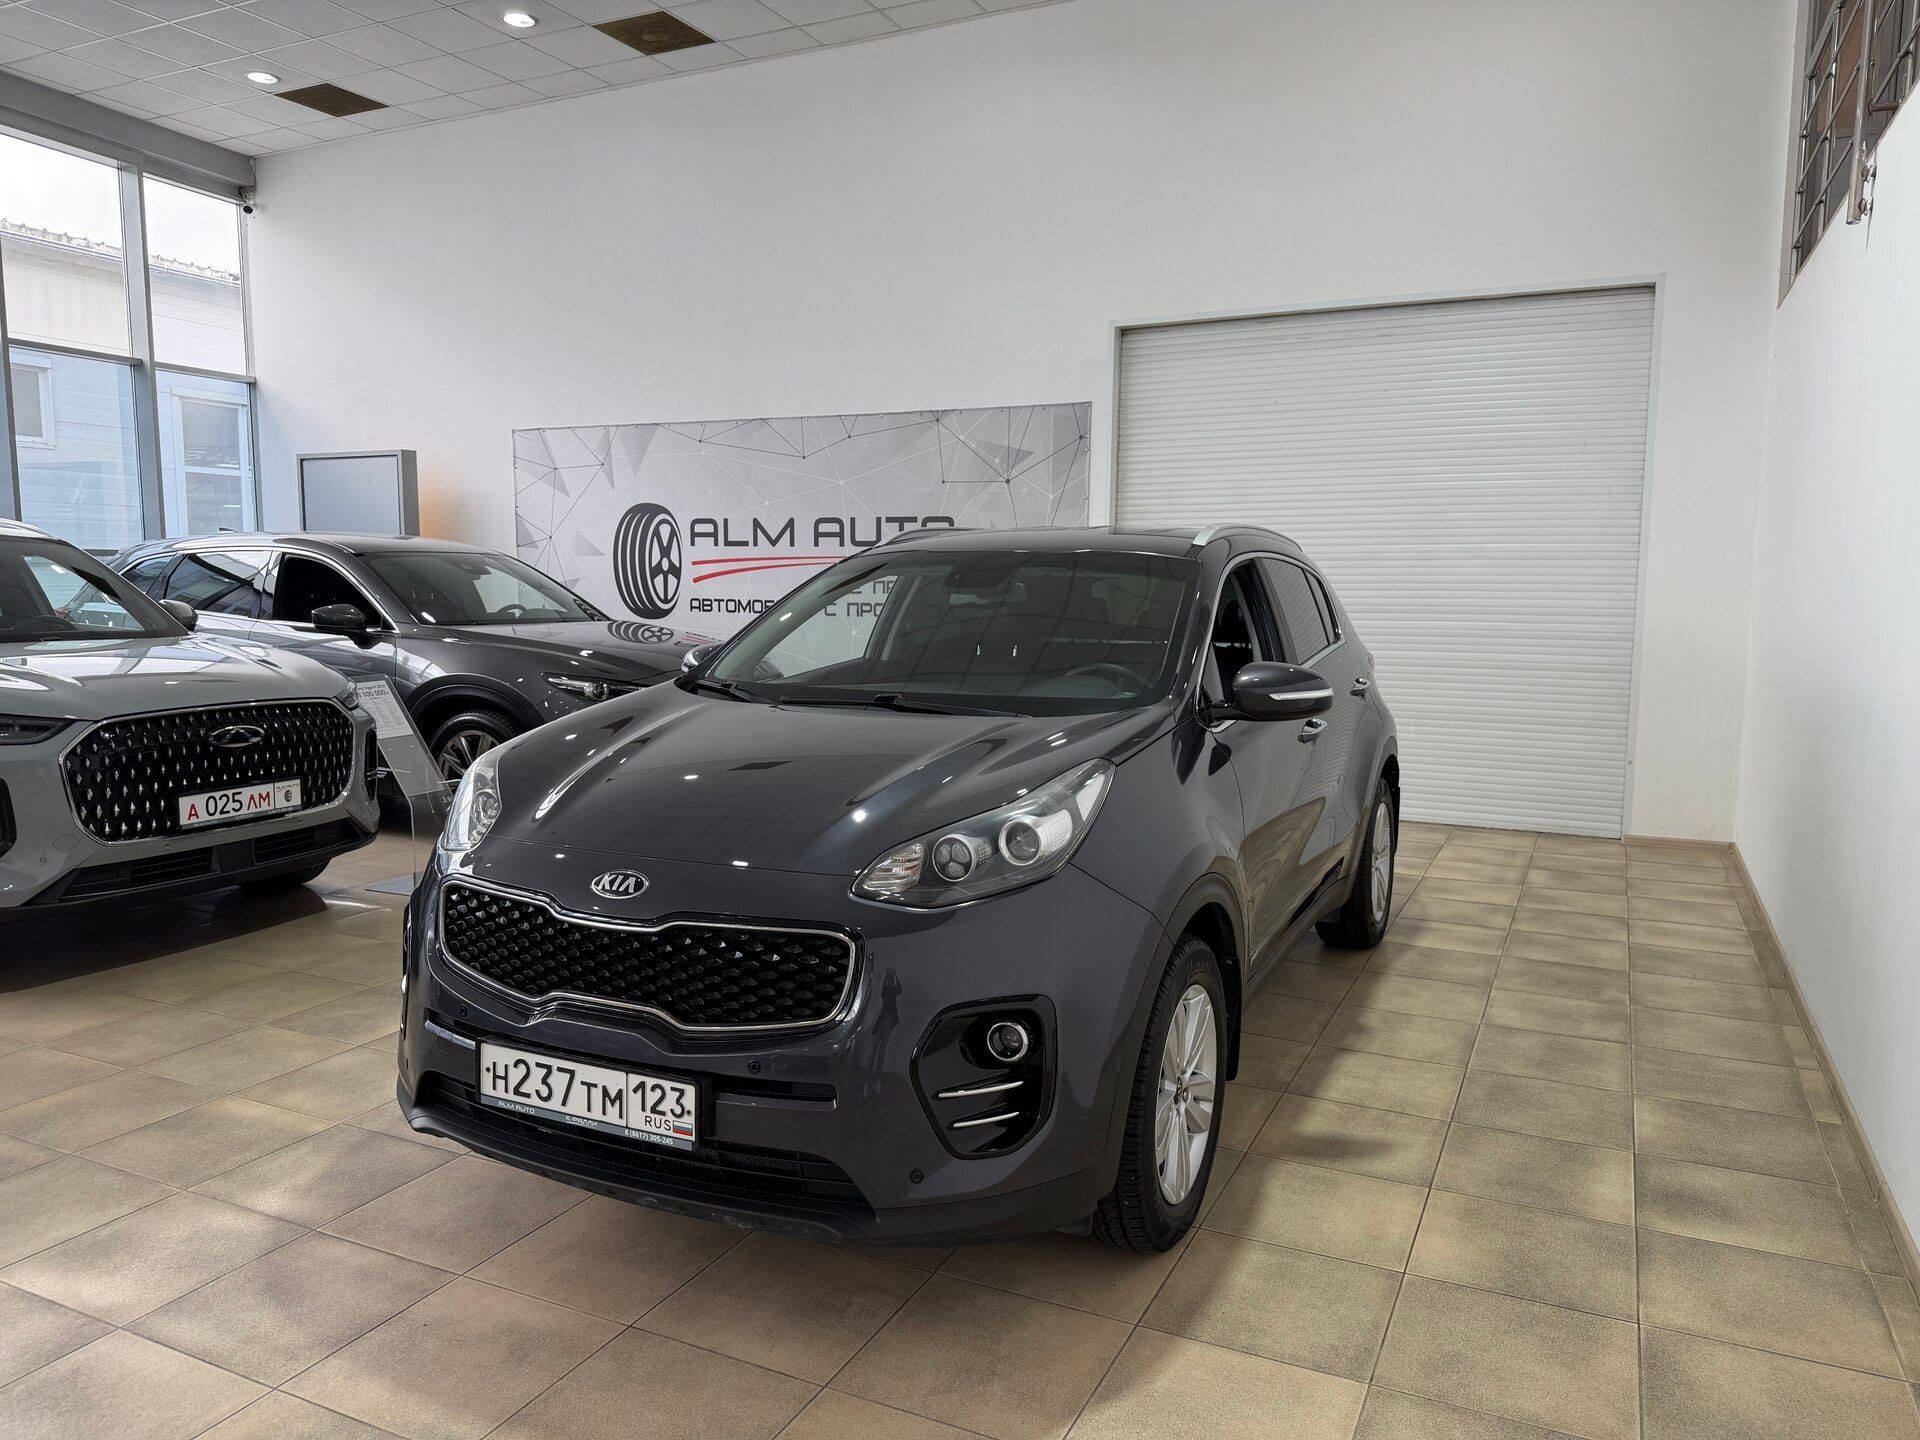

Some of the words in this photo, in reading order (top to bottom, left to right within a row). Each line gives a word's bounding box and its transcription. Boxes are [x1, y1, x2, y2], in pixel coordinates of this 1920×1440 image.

[690, 516, 795, 548] ALM
[205, 791, 243, 817] 025
[598, 874, 637, 893] KIA
[644, 1115, 672, 1132] RUS
